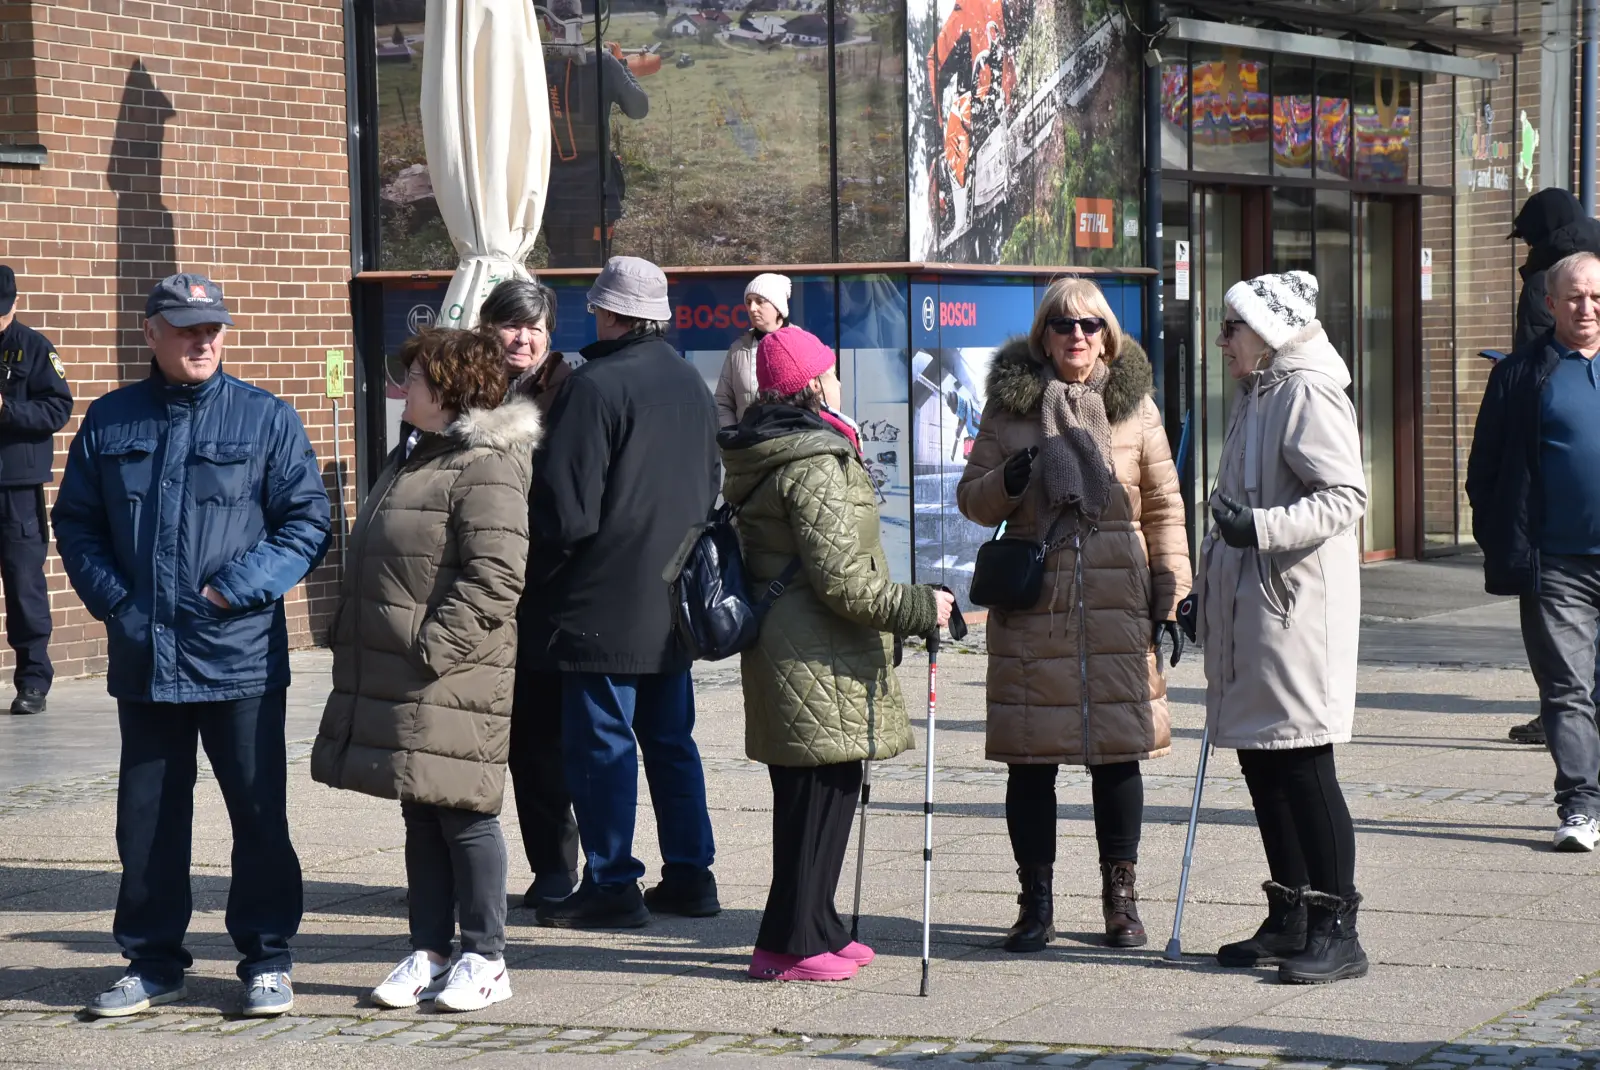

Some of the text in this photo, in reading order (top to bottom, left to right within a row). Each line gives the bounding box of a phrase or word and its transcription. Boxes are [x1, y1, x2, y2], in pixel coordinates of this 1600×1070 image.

[551, 85, 562, 118] STIHL
[1023, 91, 1057, 143] STIHL
[1477, 166, 1491, 188] and
[1494, 167, 1509, 190] kids
[1080, 213, 1108, 233] STIHL
[675, 304, 753, 329] BOSC
[940, 302, 976, 327] BOSCH
